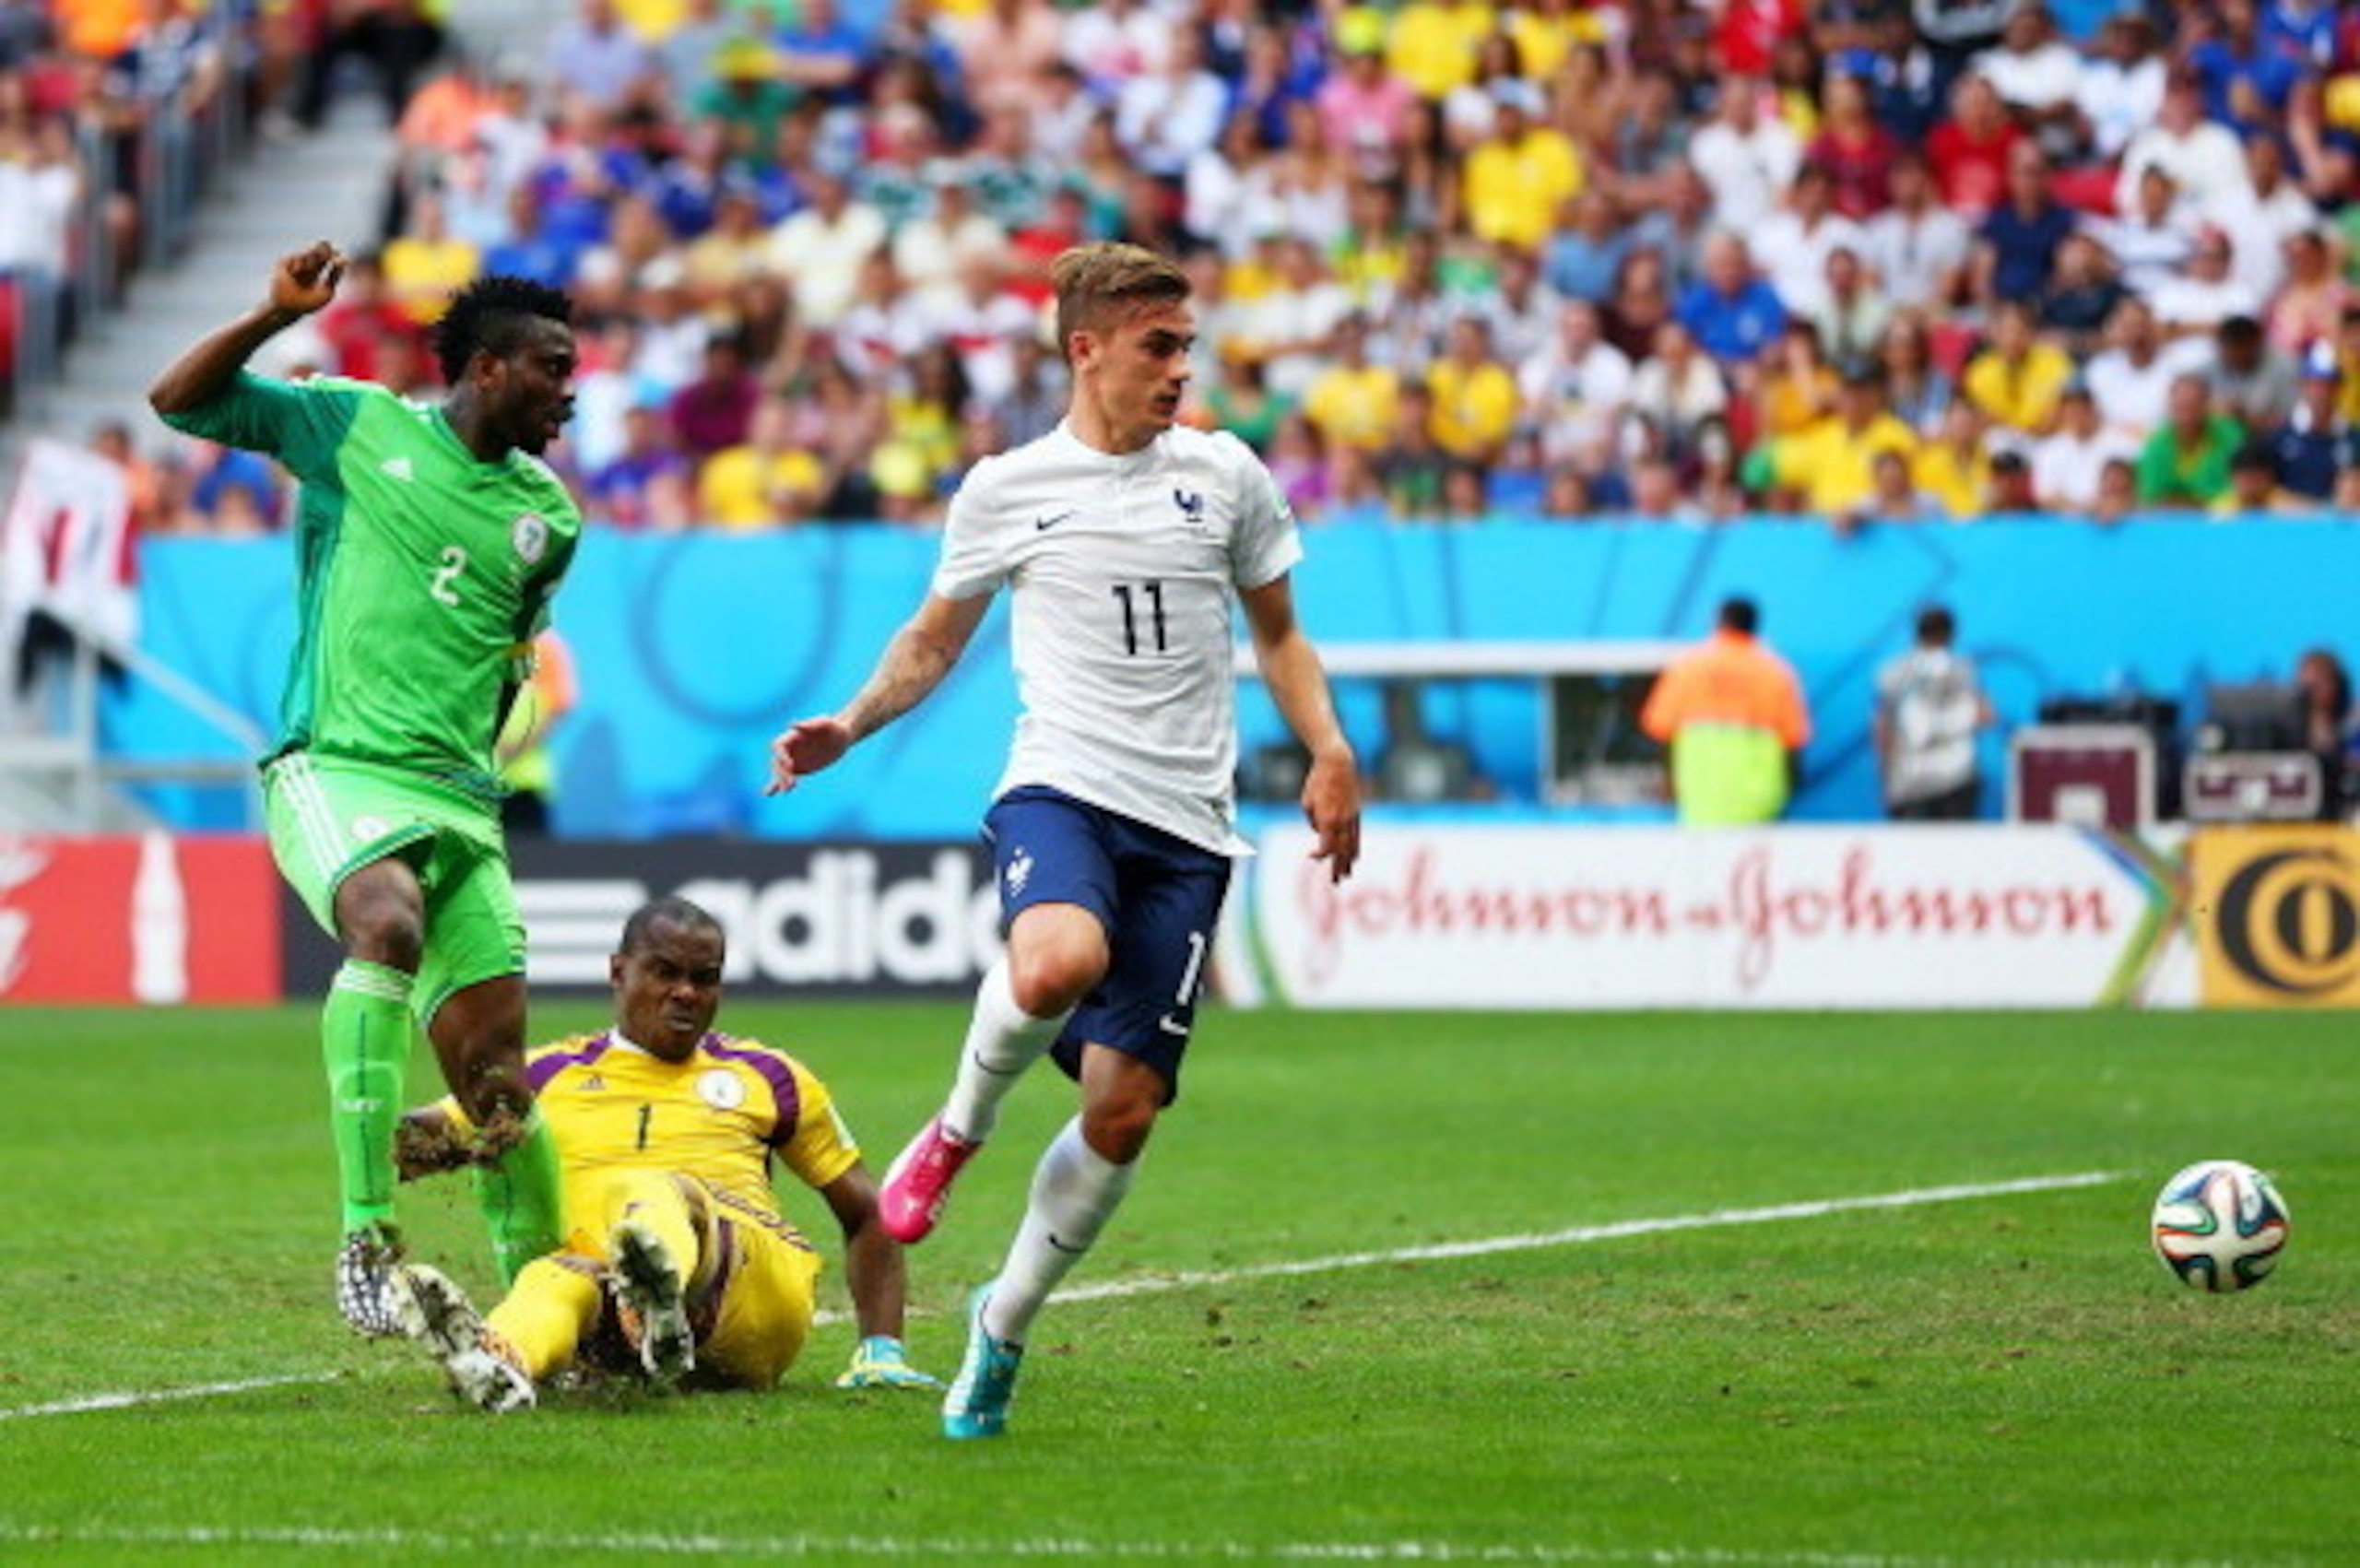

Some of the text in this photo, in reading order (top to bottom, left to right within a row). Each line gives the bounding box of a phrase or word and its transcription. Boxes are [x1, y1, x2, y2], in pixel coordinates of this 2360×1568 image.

[431, 545, 466, 607] 2
[1112, 580, 1165, 655] 11
[672, 847, 1003, 984] adid
[1295, 843, 2112, 989] Johnson Johnson
[1176, 931, 1206, 1006] 1
[638, 1103, 651, 1151] 1
